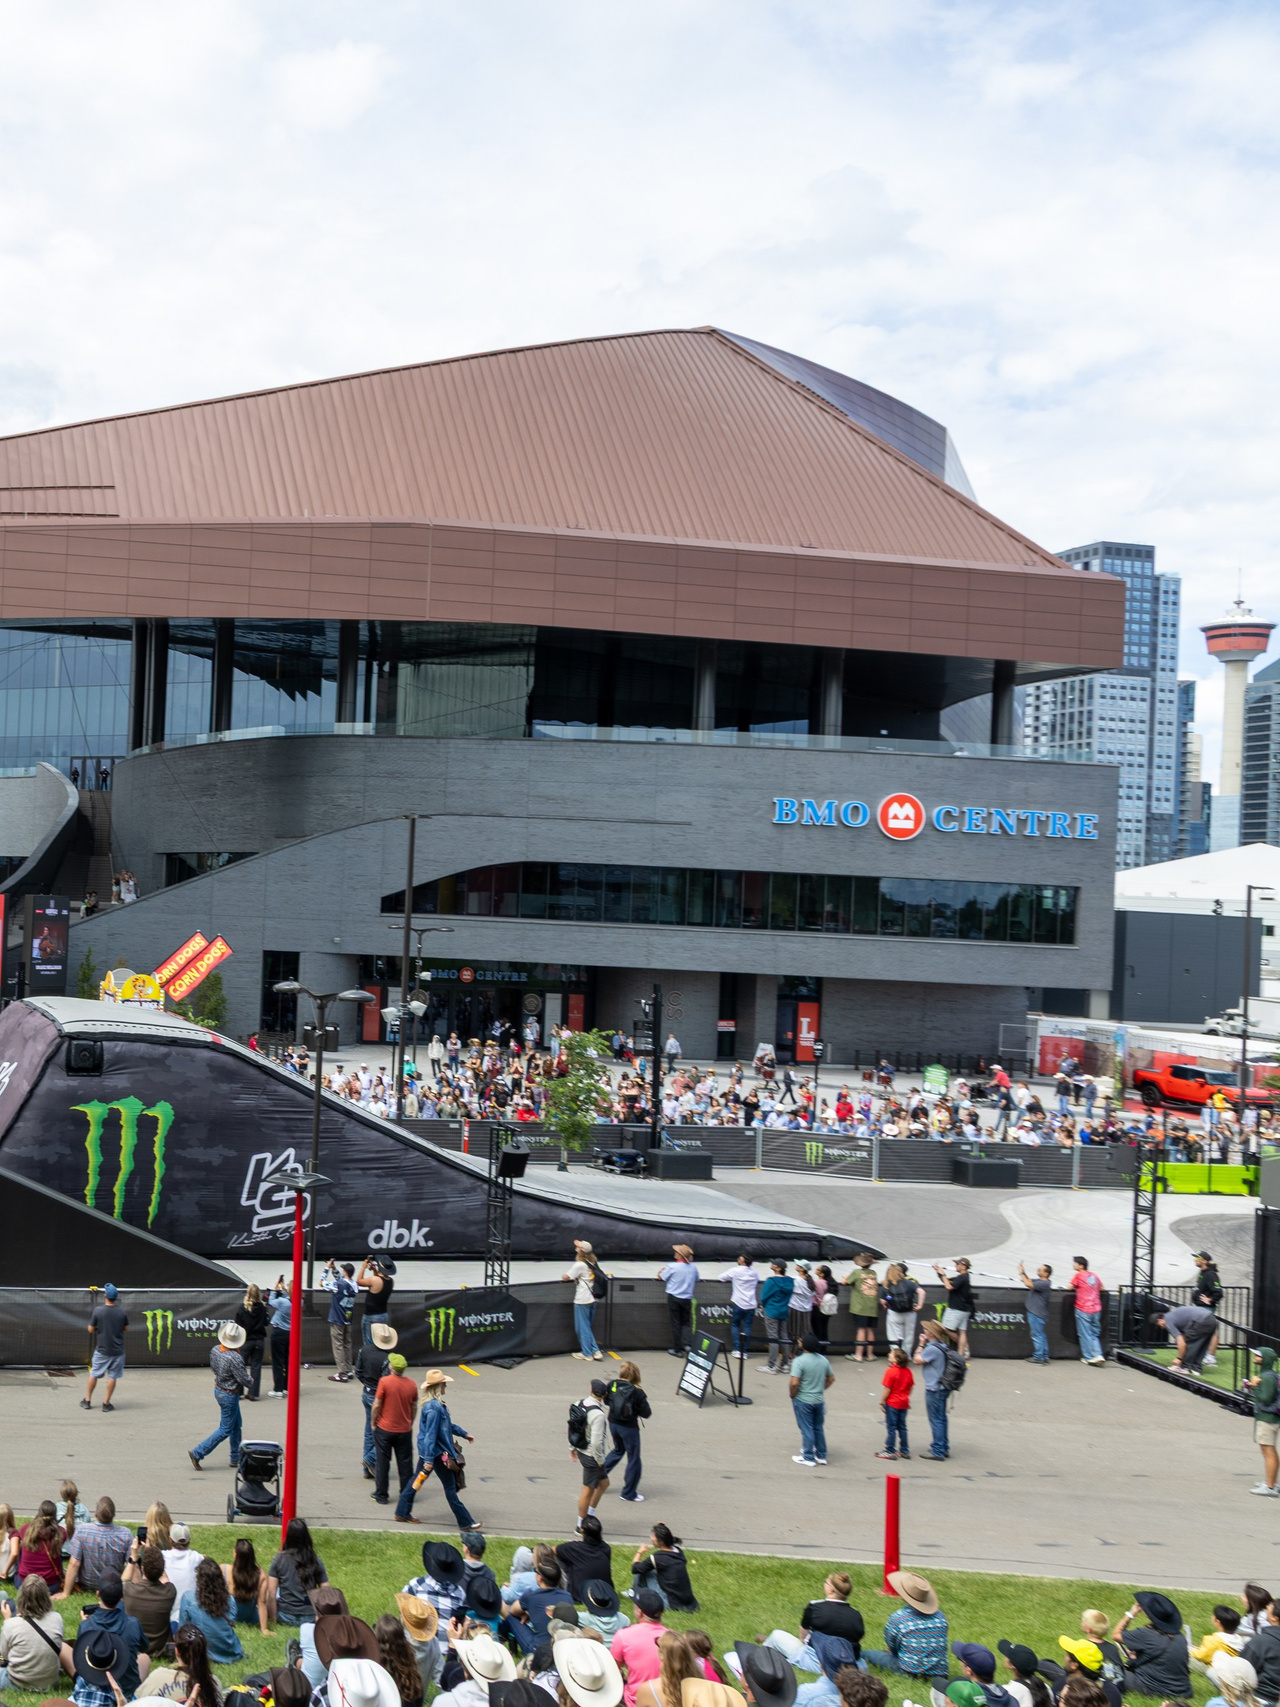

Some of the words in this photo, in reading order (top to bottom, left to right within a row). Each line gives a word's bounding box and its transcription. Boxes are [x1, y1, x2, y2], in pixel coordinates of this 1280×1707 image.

[772, 798, 869, 827] BMO
[932, 805, 1099, 839] CENTRE
[157, 961, 179, 984] ORN
[179, 937, 206, 965] DOGS
[168, 968, 200, 997] CORN
[195, 941, 227, 972] DOGS
[430, 969, 458, 979] BMO
[475, 971, 528, 982] CENTRE
[799, 1017, 816, 1038] L
[458, 1312, 514, 1327] MONSTER
[970, 1310, 1025, 1325] ONSTER
[466, 1325, 505, 1334] ENERGY
